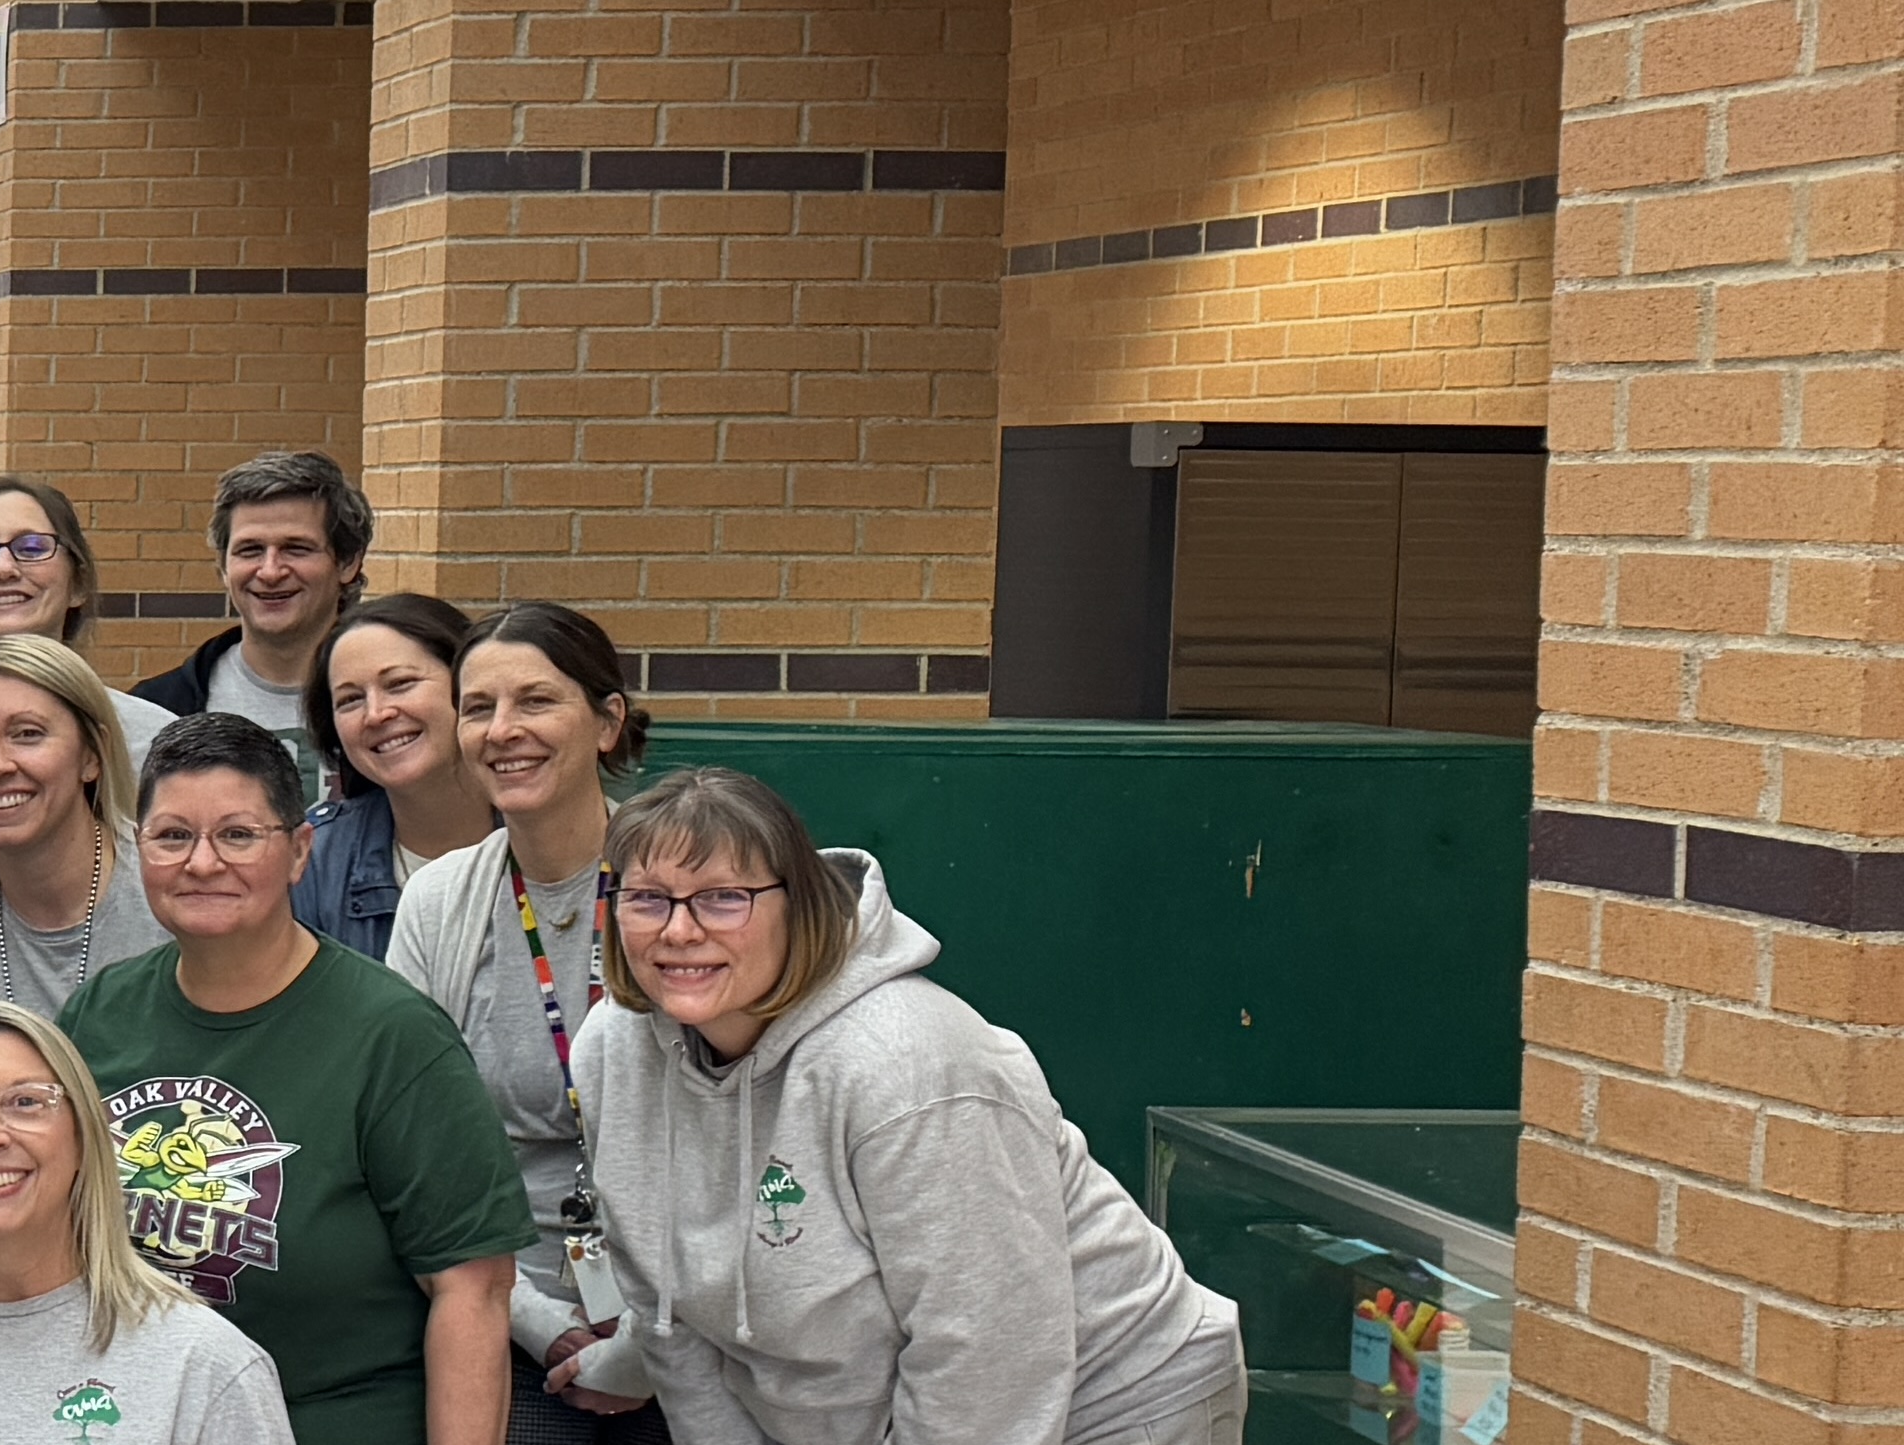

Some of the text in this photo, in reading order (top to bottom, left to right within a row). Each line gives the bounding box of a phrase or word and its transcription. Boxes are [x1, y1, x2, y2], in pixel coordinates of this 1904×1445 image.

[109, 1079, 264, 1132] OAK VALLEY
[125, 1191, 279, 1272] NETS
